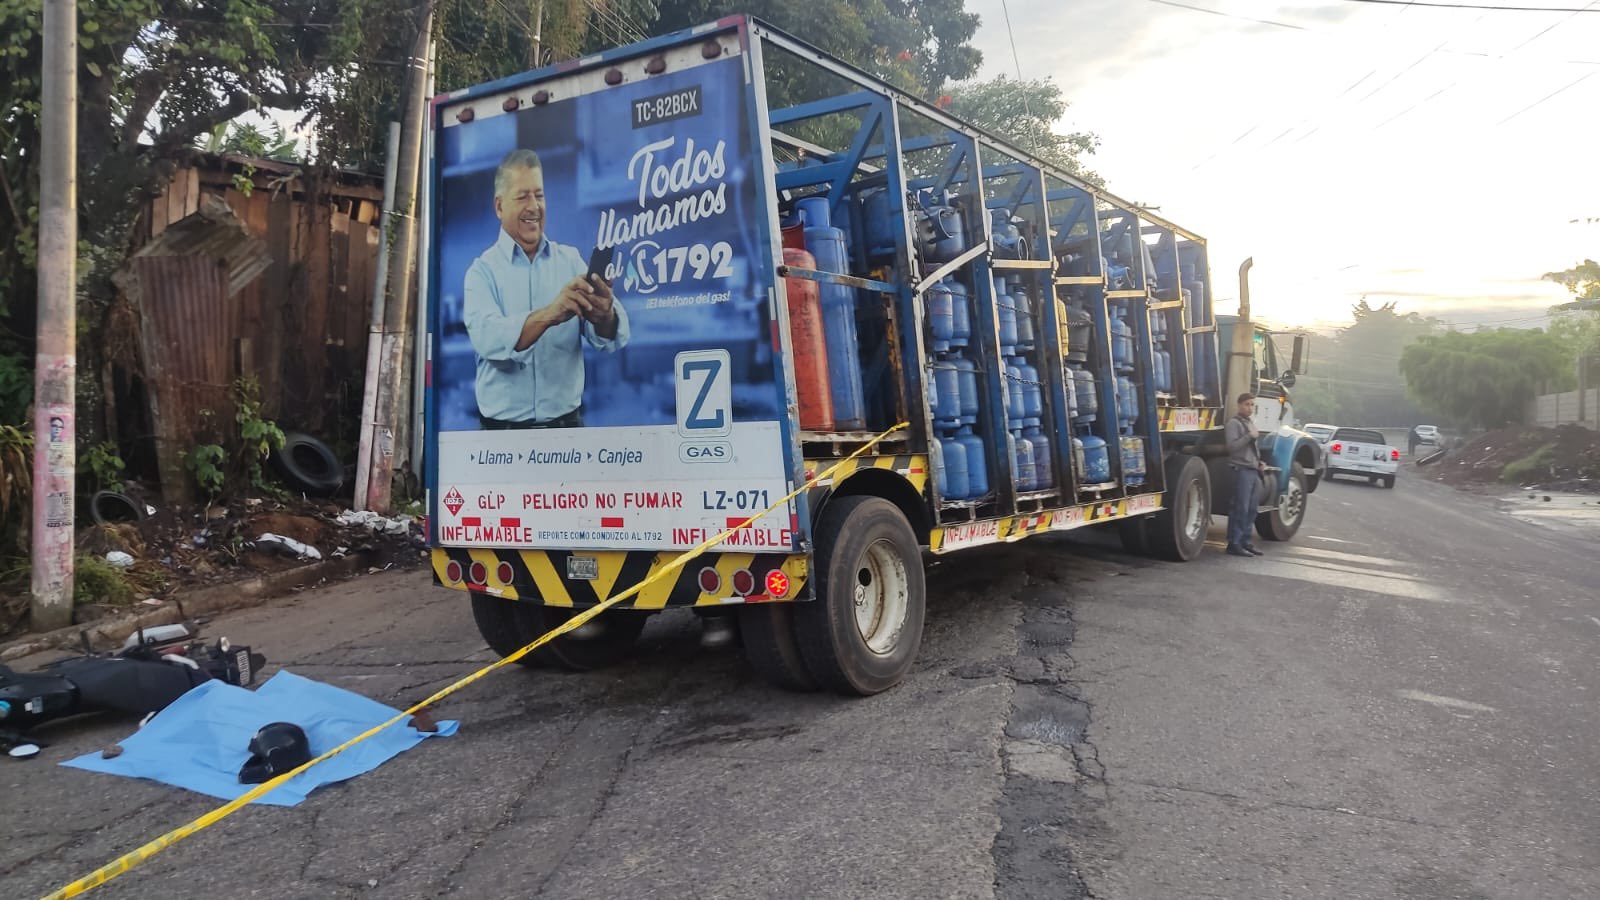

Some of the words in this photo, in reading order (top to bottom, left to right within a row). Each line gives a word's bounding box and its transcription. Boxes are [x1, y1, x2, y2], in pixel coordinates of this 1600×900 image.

[635, 90, 698, 122] TC-82BCX
[627, 135, 726, 208] Todos
[597, 182, 726, 251] llamamos
[604, 251, 624, 281] al
[652, 241, 734, 284] 1792
[695, 292, 709, 305] del
[682, 359, 724, 429] Z
[478, 449, 514, 465] Llama
[527, 448, 582, 464] Acumula
[597, 447, 643, 466] Canjea
[686, 446, 725, 458] GAS
[478, 494, 506, 510] GLP
[522, 493, 589, 510] PELIGRO
[595, 493, 617, 509] NO
[623, 491, 683, 509] FUMAR
[703, 489, 769, 510] LZ-071
[441, 526, 533, 543] INFLAMABLE
[538, 531, 568, 540] REPORTE
[570, 531, 590, 540] COMO
[631, 532, 642, 540] AL
[643, 532, 663, 541] 1792
